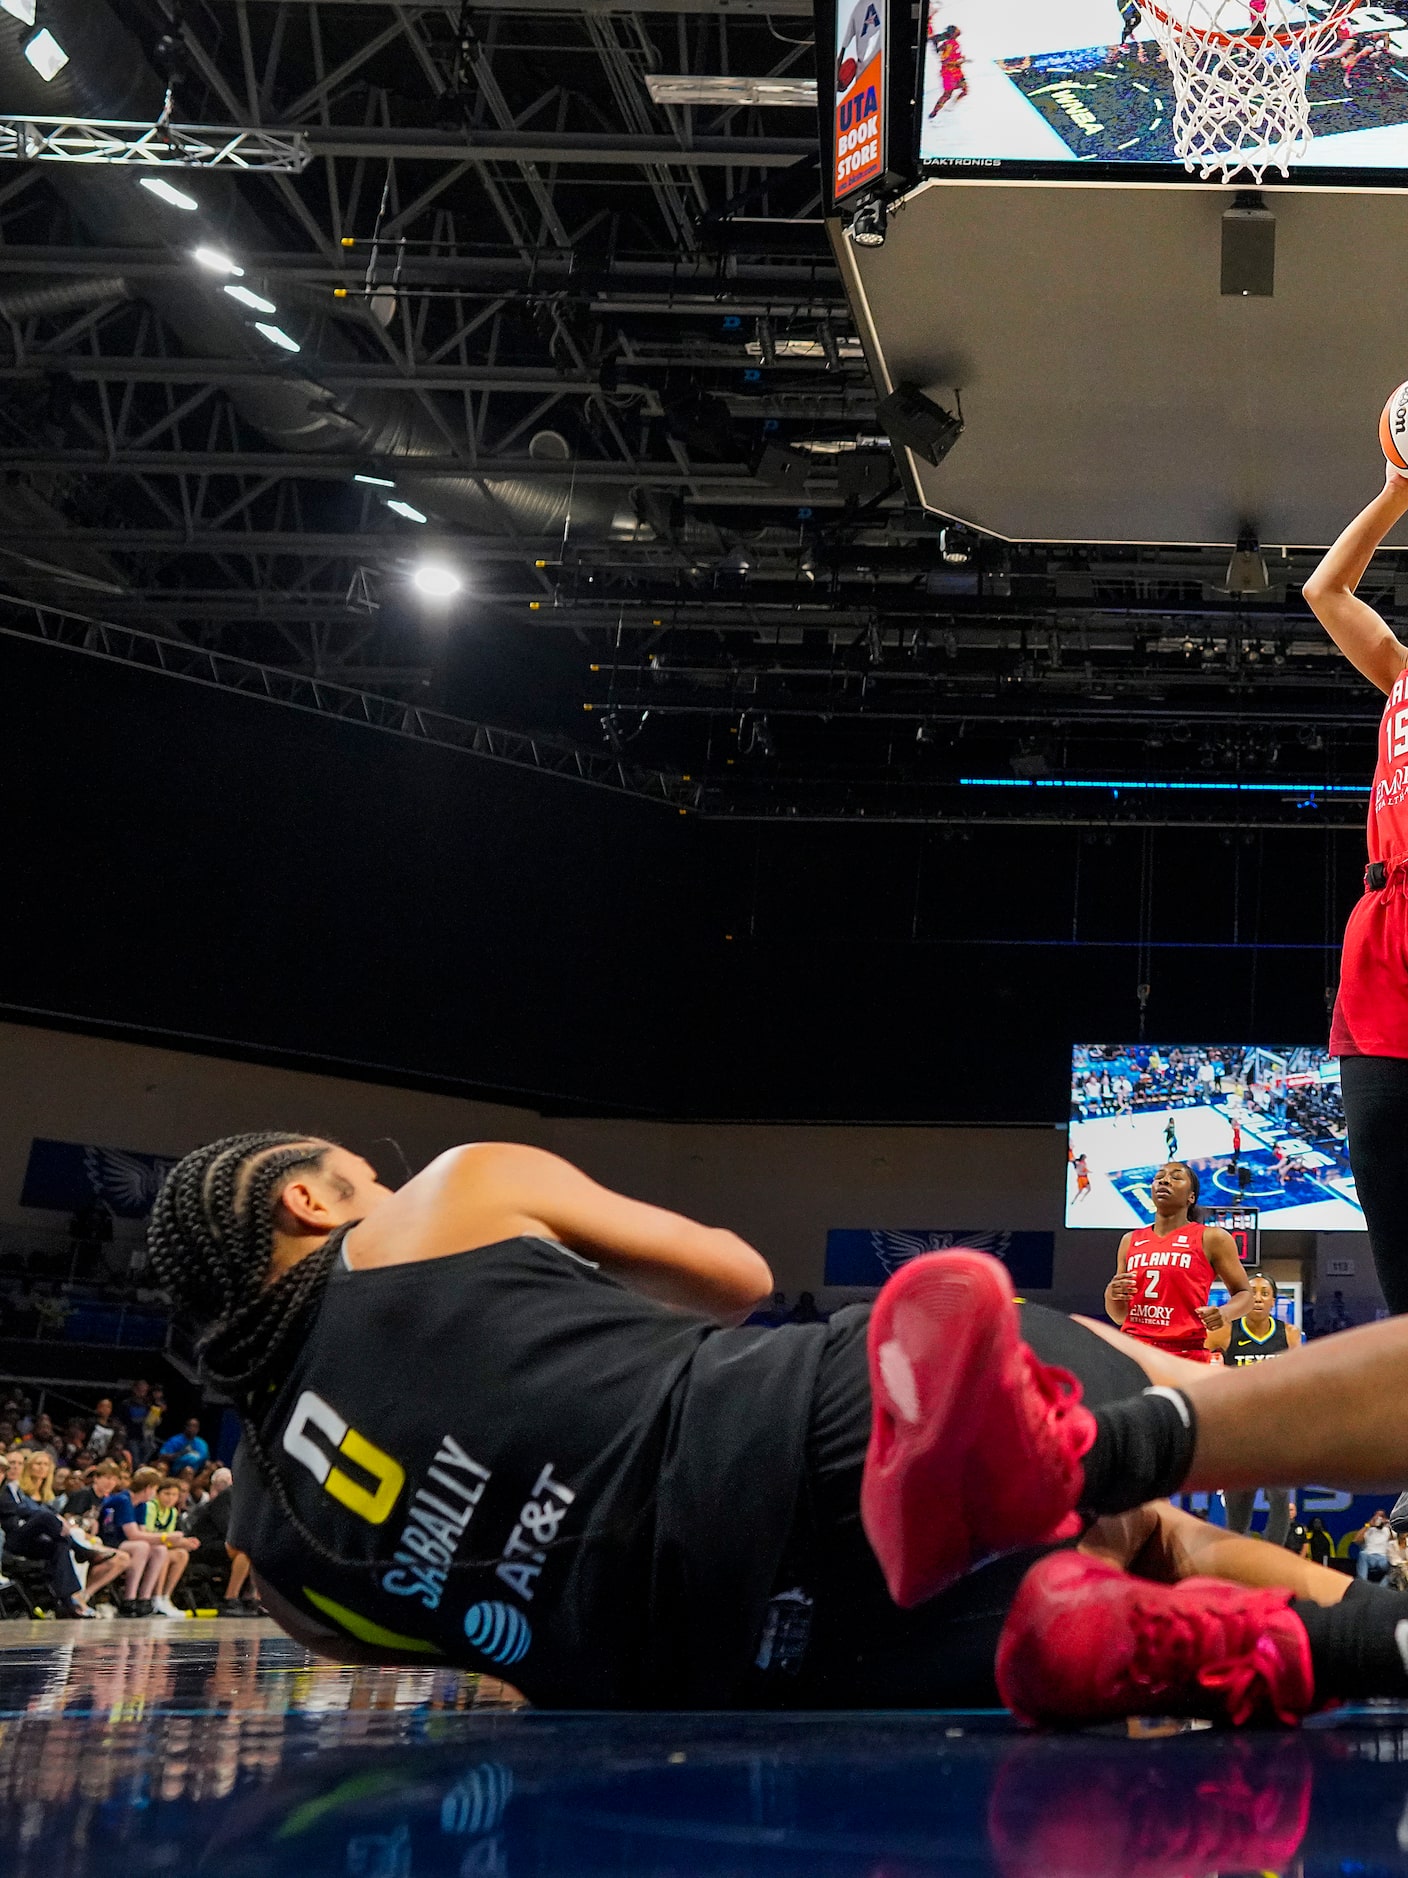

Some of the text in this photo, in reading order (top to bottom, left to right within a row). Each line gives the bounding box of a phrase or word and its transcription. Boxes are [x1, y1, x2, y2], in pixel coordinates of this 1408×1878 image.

[840, 85, 878, 132] UTA
[838, 115, 878, 157] BOOK
[837, 139, 878, 180] STORE
[923, 158, 1001, 167] DAKTRONICS
[1127, 1252, 1191, 1272] ATLANTA
[1144, 1270, 1161, 1299] 2
[1130, 1304, 1174, 1320] EMORY
[283, 1390, 406, 1525] 0
[496, 1462, 576, 1601] AT&T
